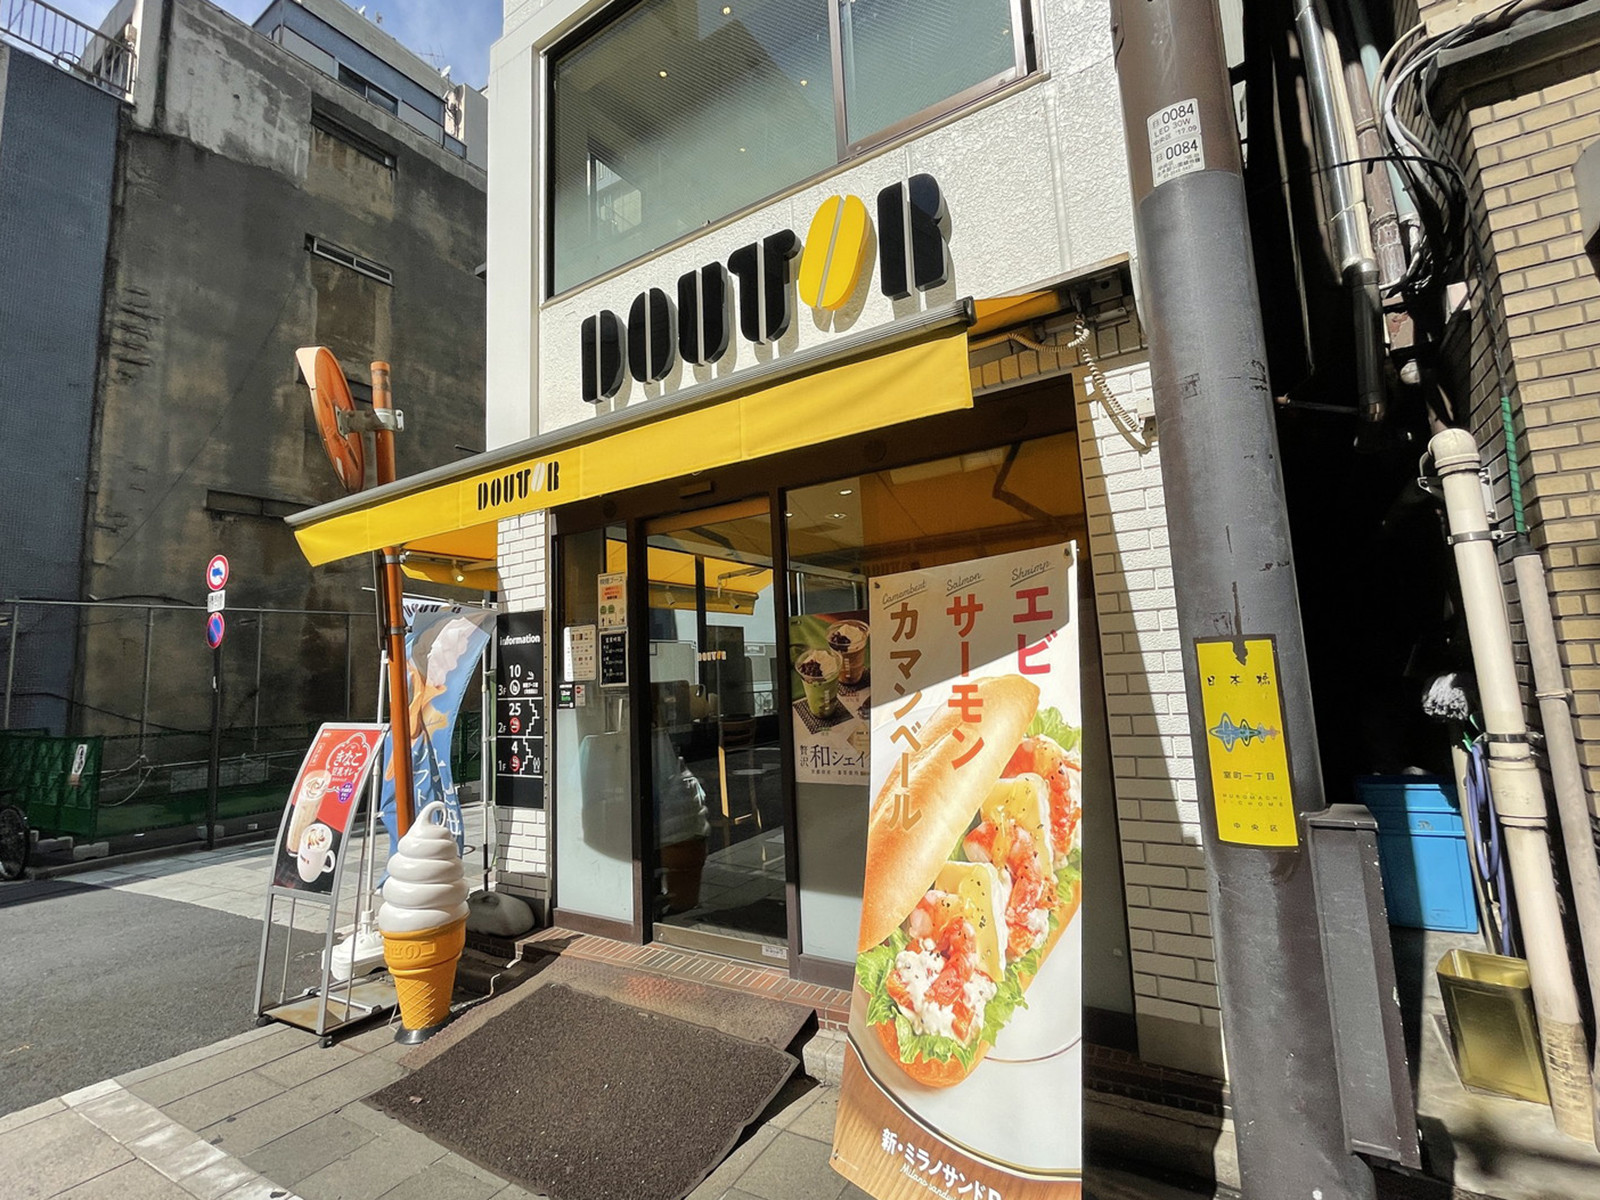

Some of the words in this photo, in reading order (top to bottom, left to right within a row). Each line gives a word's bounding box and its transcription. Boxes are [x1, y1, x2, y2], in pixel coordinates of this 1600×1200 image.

[1161, 103, 1194, 124] 0084
[1154, 125, 1170, 138] LED
[1173, 118, 1191, 129] 30W
[1165, 139, 1198, 160] 0084
[580, 173, 947, 403] DOUTOR
[477, 461, 560, 511] DOUTOR
[1010, 559, 1053, 586] Shrimp
[945, 571, 984, 595] Salmon
[499, 633, 541, 646] information
[1012, 586, 1058, 675] エビ
[509, 664, 521, 678] 10
[498, 684, 507, 696] 3F
[946, 593, 985, 770] サーモン
[509, 702, 521, 716] 25
[889, 602, 923, 831] カマンベール
[497, 722, 506, 734] 2F
[511, 741, 518, 754] 4
[333, 750, 363, 767] きなこ
[498, 760, 506, 771] 1F
[1222, 793, 1283, 801] MUROMACHI
